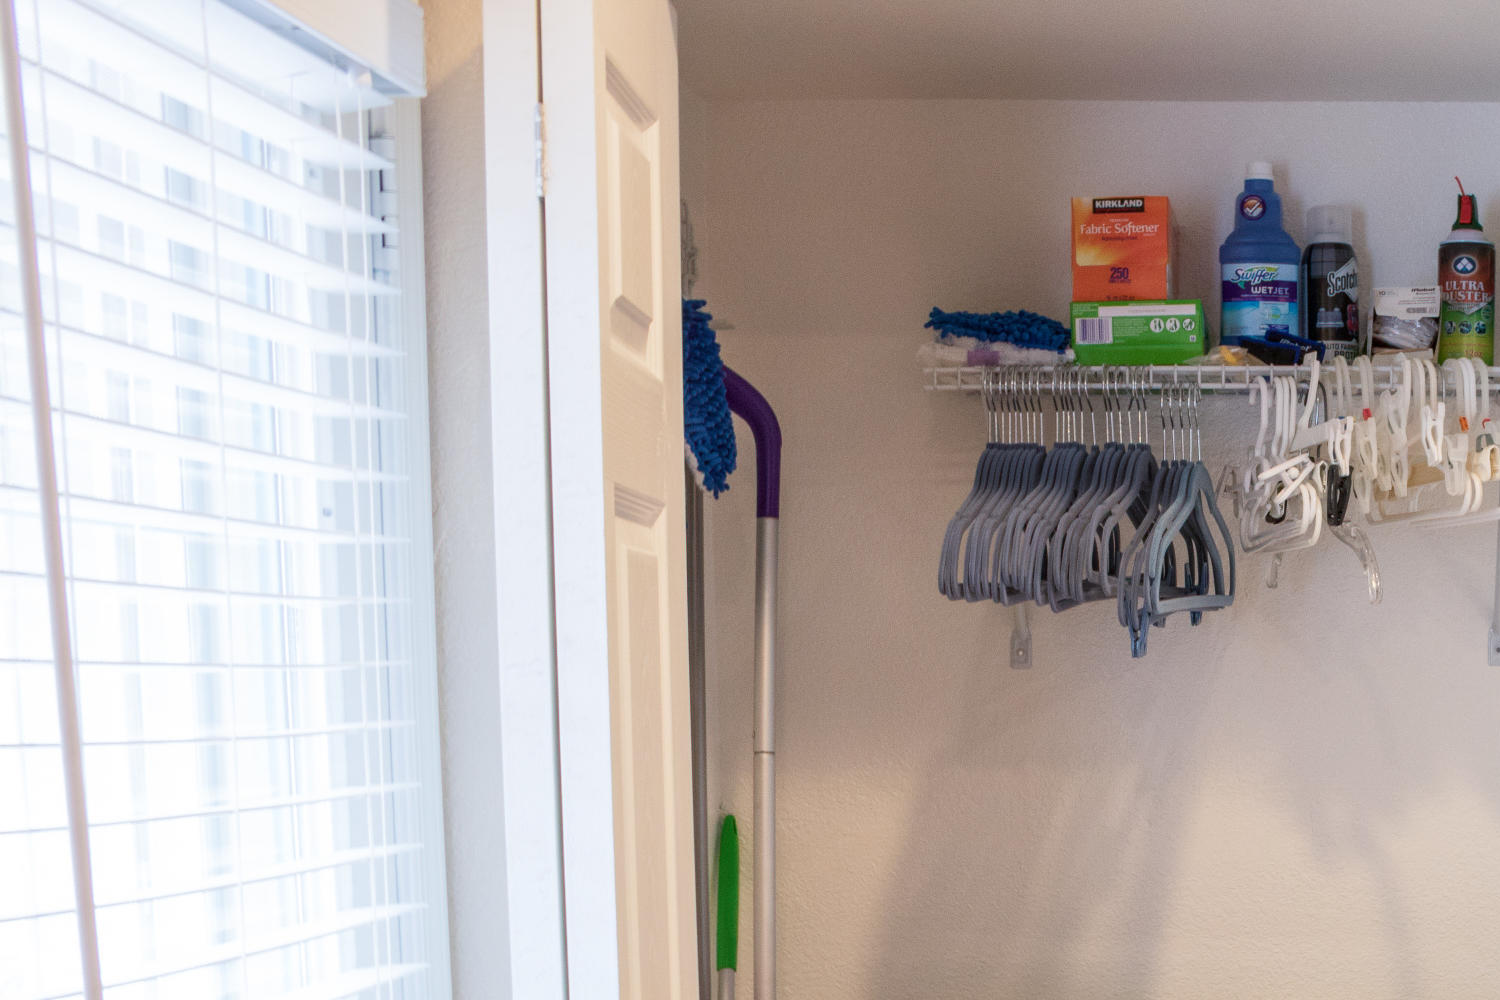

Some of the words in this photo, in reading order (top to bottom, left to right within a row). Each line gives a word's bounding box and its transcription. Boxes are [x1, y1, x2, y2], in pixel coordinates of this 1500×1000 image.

[1095, 200, 1143, 208] KIRKLAND
[1080, 224, 1111, 234] Fabric
[1114, 221, 1160, 236] Softener
[1110, 267, 1128, 279] 250
[1231, 267, 1276, 285] Swiffer
[1446, 280, 1485, 290] ULTRA
